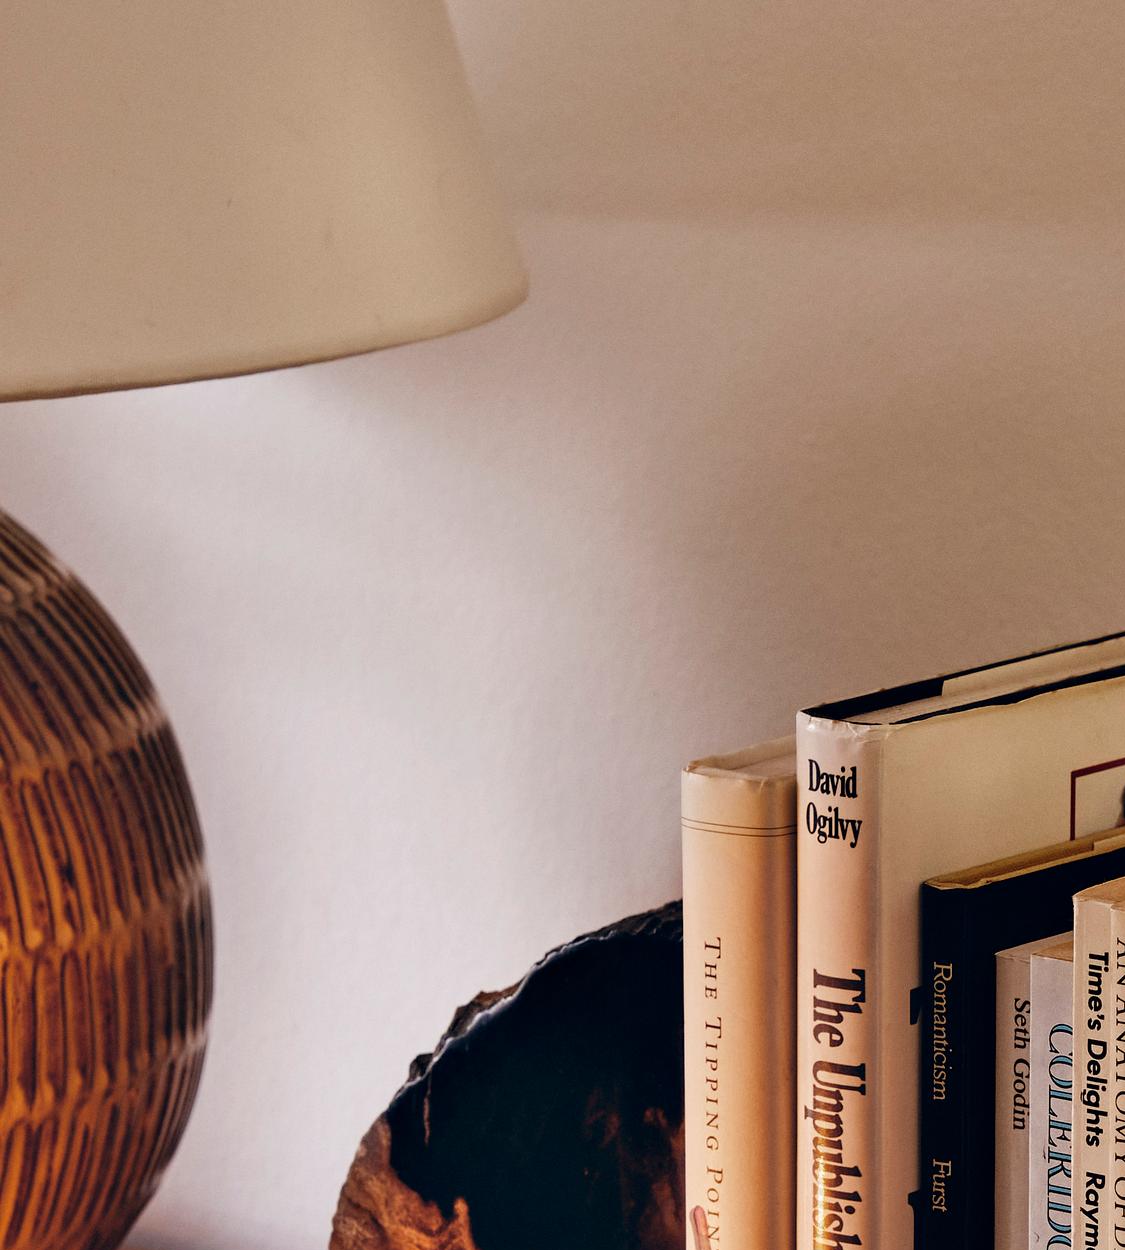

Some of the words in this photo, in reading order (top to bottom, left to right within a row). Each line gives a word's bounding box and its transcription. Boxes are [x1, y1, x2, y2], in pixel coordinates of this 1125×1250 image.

[808, 759, 858, 798] David
[806, 802, 863, 848] Ogilvy
[812, 968, 866, 1048] The
[1013, 998, 1031, 1049] Seth
[1088, 952, 1109, 1031] Time's
[933, 961, 953, 1101] Romanticism
[1013, 1058, 1029, 1130] Godin
[1081, 1039, 1108, 1147] Delights
[932, 1159, 952, 1213] Furst
